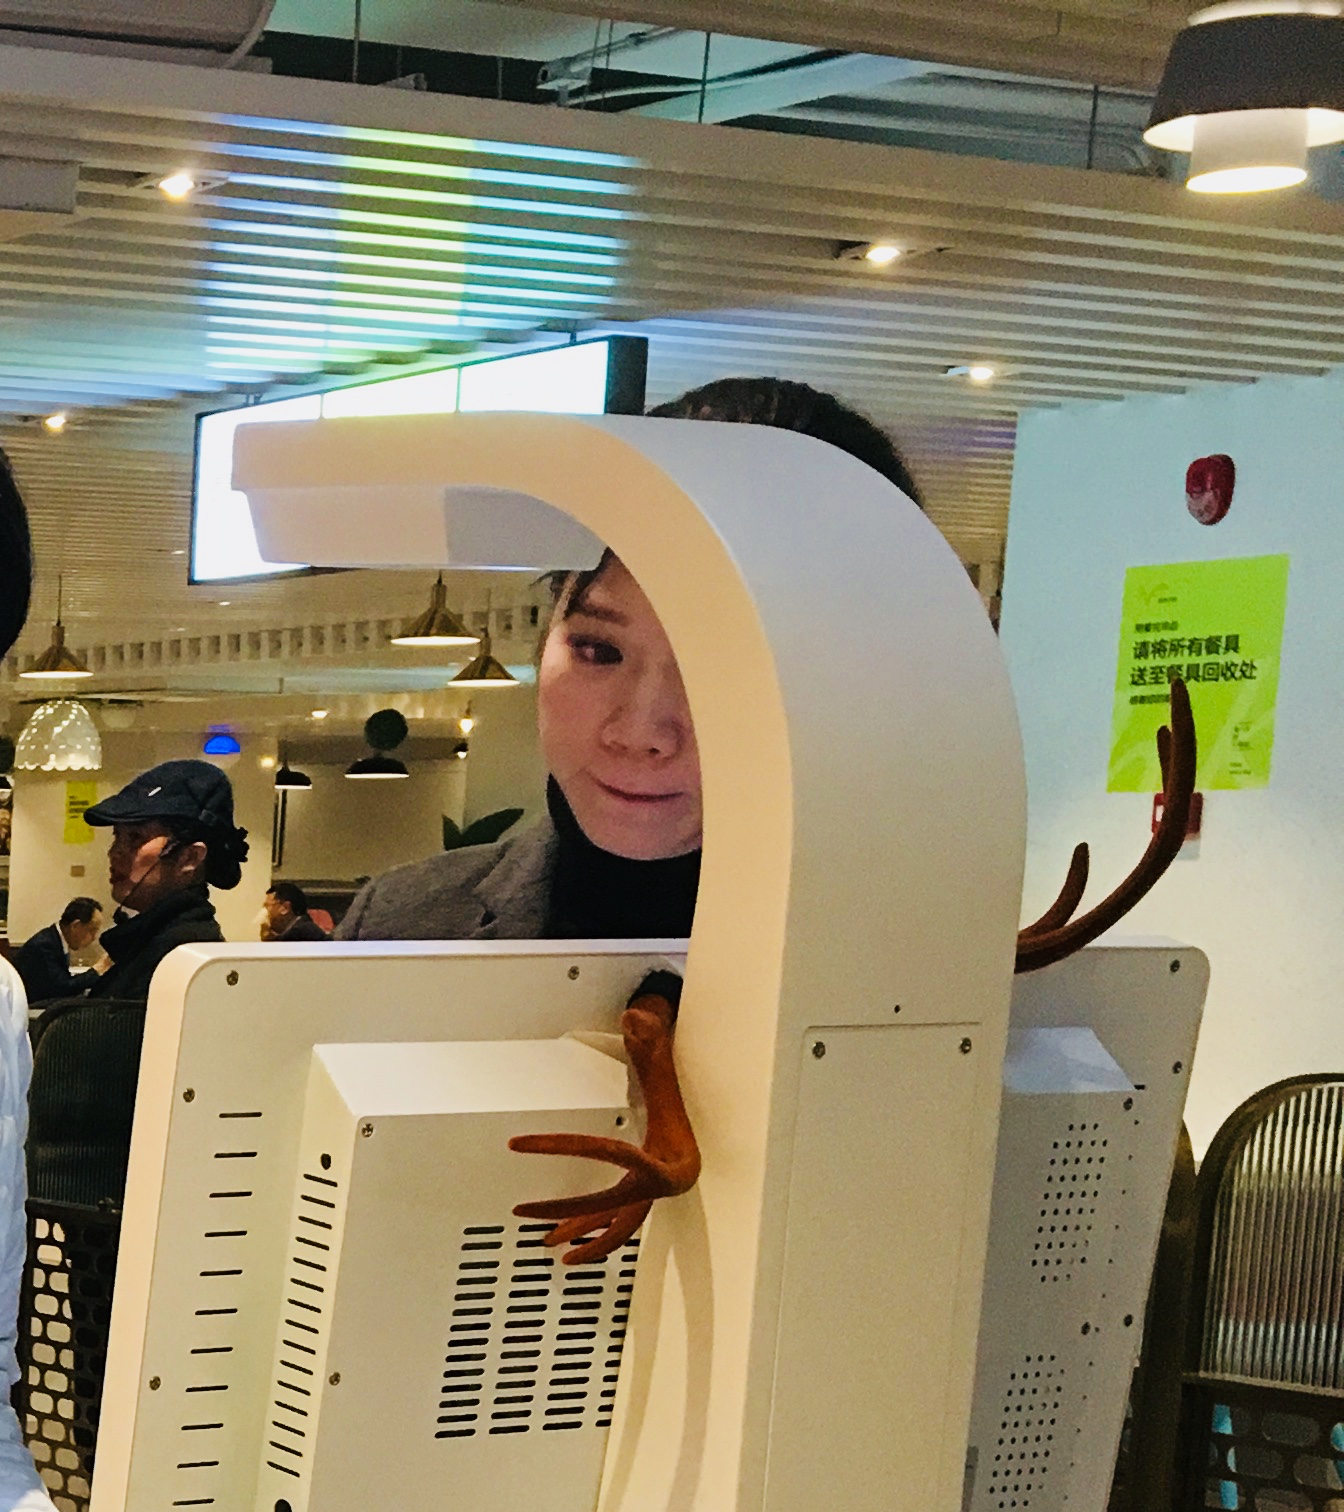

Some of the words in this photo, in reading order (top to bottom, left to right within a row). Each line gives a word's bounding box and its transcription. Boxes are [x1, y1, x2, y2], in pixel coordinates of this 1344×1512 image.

[1133, 634, 1240, 660] 请将所有餐具
